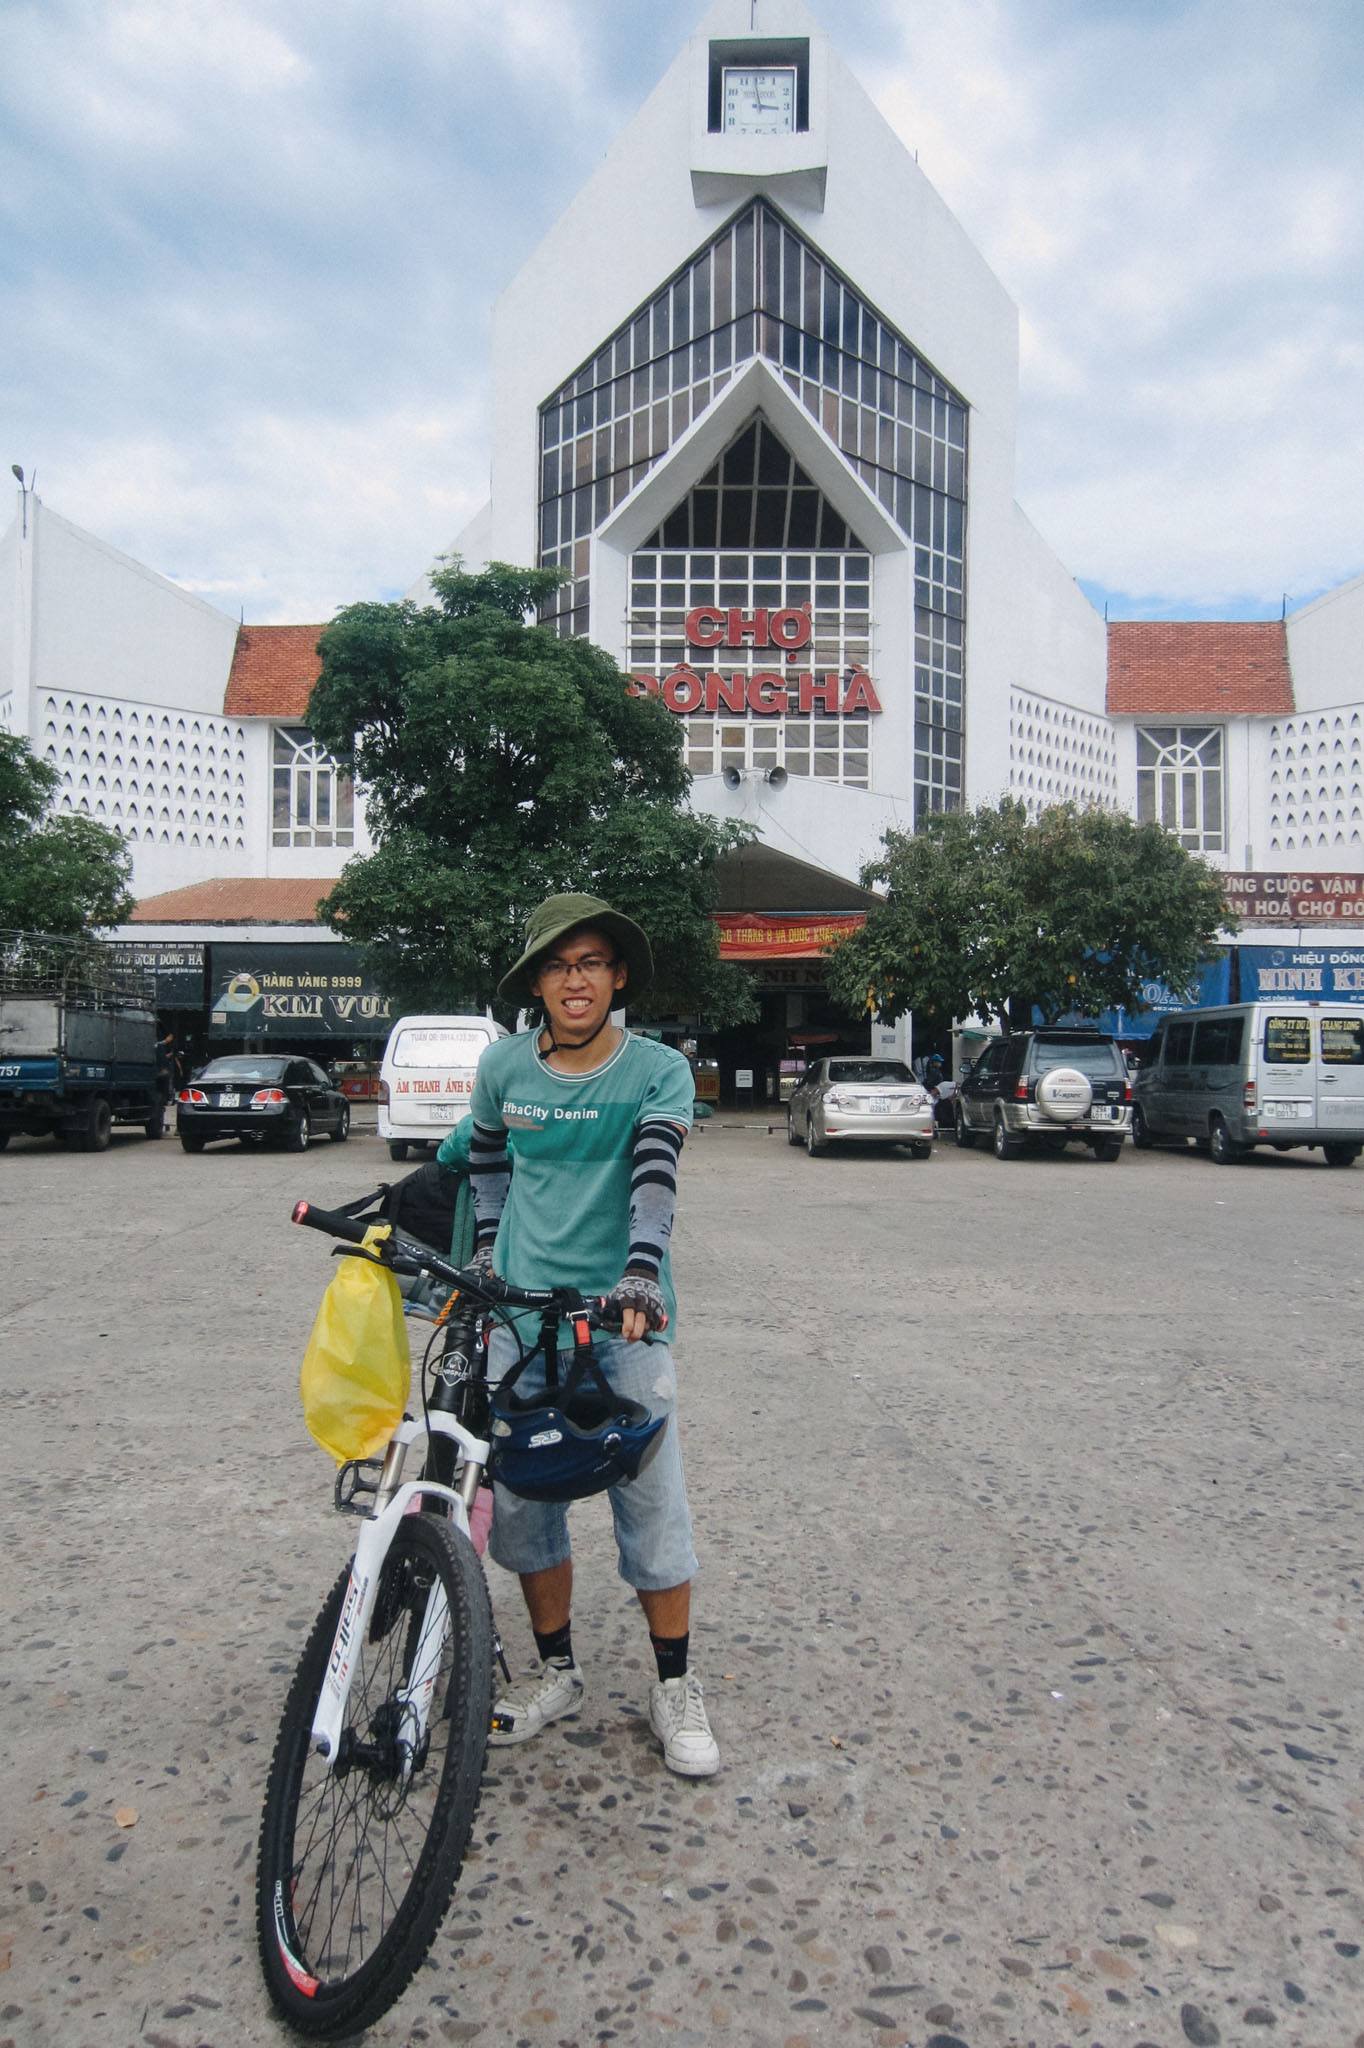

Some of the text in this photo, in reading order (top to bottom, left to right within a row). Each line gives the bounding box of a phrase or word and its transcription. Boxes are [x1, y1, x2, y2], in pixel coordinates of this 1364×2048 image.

[685, 601, 813, 664] CHỢ
[799, 663, 883, 713] HÀ
[1263, 875, 1314, 897] CUỘC
[1320, 876, 1356, 897] VẬN
[1226, 897, 1248, 915] ĂN
[1298, 899, 1336, 918] CHỢ
[188, 950, 204, 966] HÀ
[1292, 951, 1325, 966] HIỆU
[263, 971, 363, 988] HÀNG VÀNG 9999
[1258, 968, 1323, 991] MINH
[261, 994, 323, 1018] KIM
[396, 1077, 410, 1093] ÂM
[413, 1080, 441, 1093] THANH
[445, 1077, 464, 1093] ÁNH
[502, 1101, 598, 1120] EfbaCity Denim
